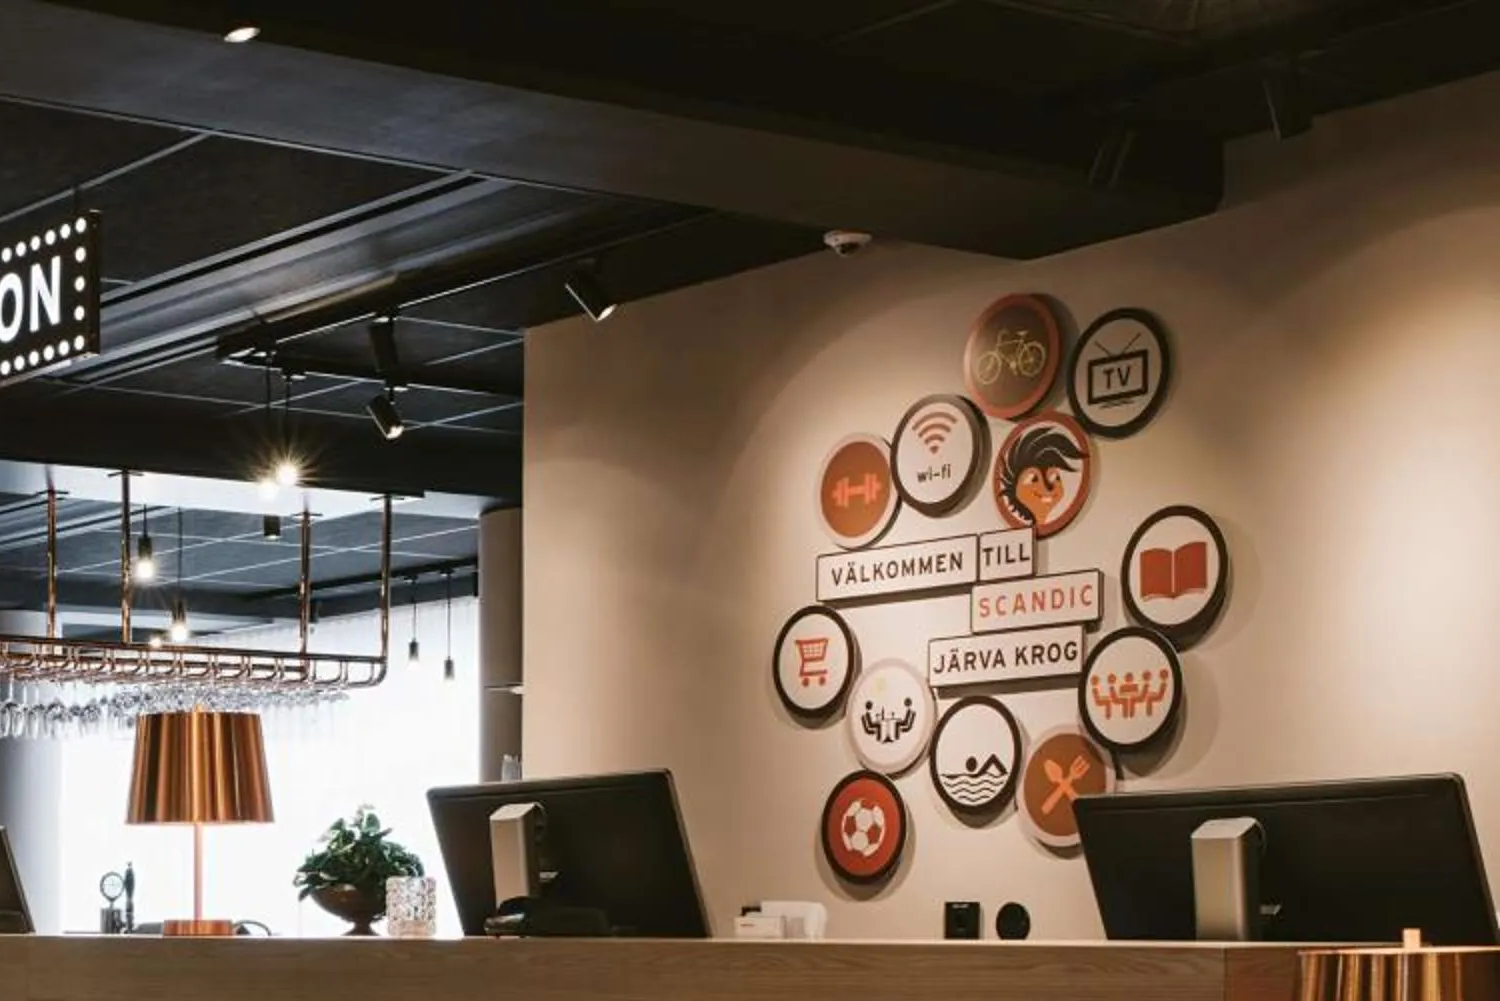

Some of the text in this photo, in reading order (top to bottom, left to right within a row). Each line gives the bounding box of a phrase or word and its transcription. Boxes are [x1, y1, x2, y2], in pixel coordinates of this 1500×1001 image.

[1102, 365, 1132, 390] TV
[917, 463, 951, 483] wi-fi
[831, 542, 1031, 587] VÄLKOMMEN TILL
[979, 584, 1094, 618] SCANDIC
[933, 640, 1078, 674] JÄRVA KROG
